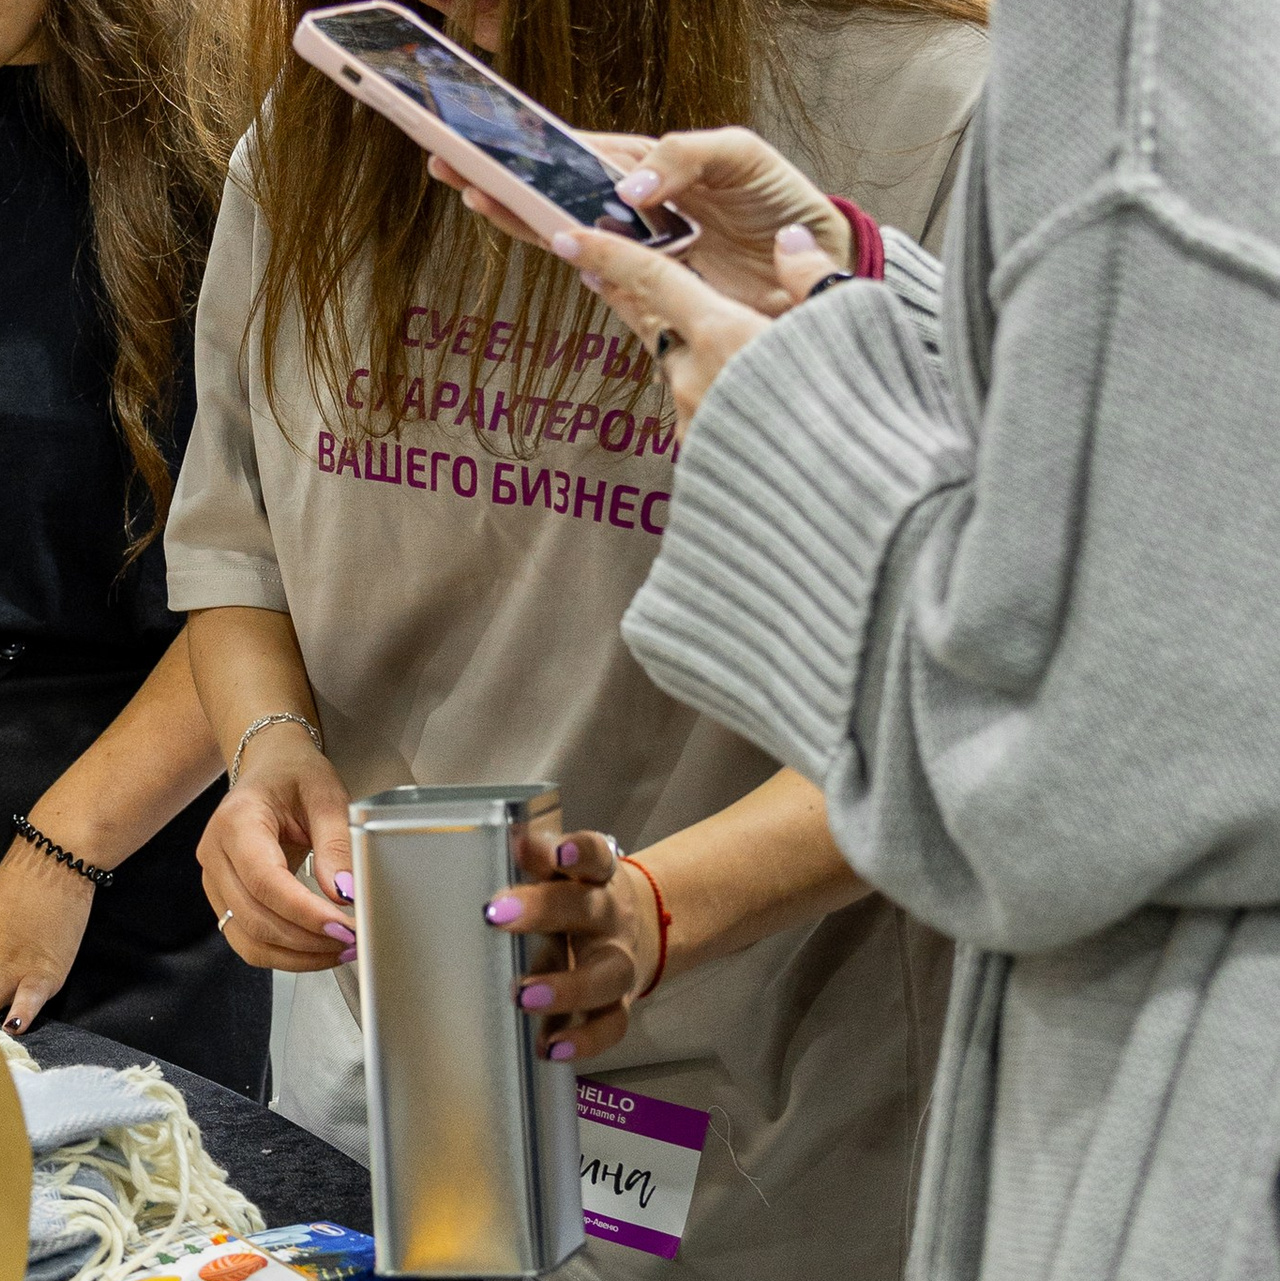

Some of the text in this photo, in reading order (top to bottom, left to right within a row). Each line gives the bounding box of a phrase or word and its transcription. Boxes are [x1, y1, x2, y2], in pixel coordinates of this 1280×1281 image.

[400, 305, 647, 382] СУВЕНИРЫ
[346, 368, 369, 410] С
[318, 431, 478, 499] ВАШЕГО
[577, 1085, 634, 1112] HELLO
[589, 1107, 616, 1122] name
[618, 1112, 626, 1124] is
[584, 1216, 619, 1232] р-Авеню
